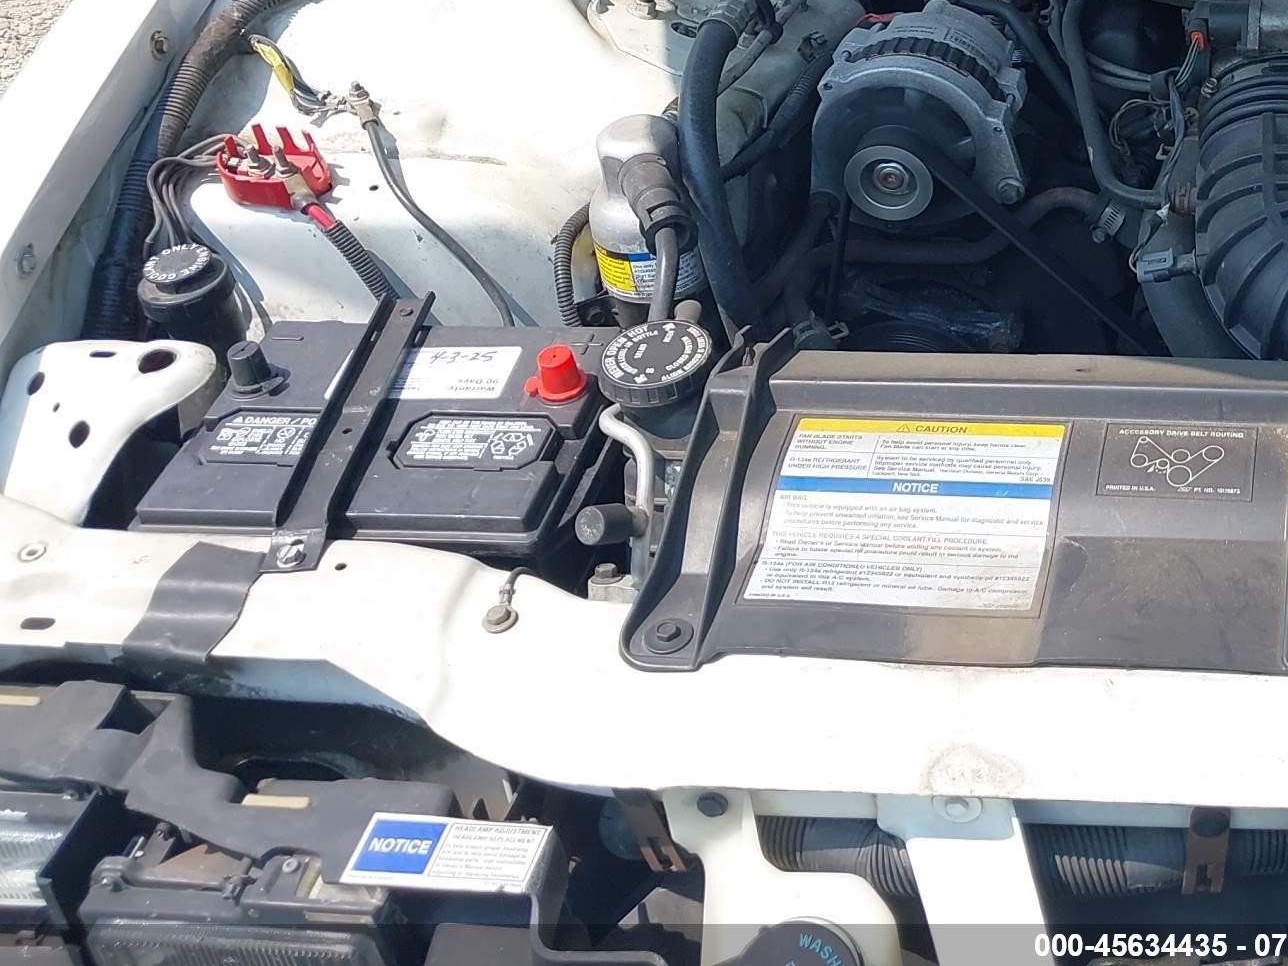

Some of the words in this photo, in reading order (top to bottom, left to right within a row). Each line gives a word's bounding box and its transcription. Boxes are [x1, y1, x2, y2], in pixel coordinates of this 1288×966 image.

[161, 242, 201, 255] ONLY
[143, 255, 177, 281] COOLANT
[181, 247, 210, 276] ENGINE
[627, 324, 649, 338] HOT
[631, 330, 659, 343] BOTTLE
[606, 336, 628, 356] OPEN
[430, 350, 499, 365] 4-3-25
[604, 356, 625, 379] NEVER
[457, 377, 484, 385] Days
[449, 385, 496, 393] Warranty
[244, 416, 291, 425] DANGER
[915, 425, 969, 434] CAUTION
[1118, 428, 1166, 436] ACCESSORY
[1166, 429, 1191, 437] DRIVE
[1191, 430, 1209, 438] BELT
[1209, 430, 1245, 439] ROUTING
[892, 481, 941, 494] NOTICE
[1105, 483, 1131, 492] PRINTED
[1131, 484, 1139, 492] IN
[454, 825, 494, 834] HEADLAMP
[494, 826, 543, 836] ADJUSTMENT
[367, 837, 434, 855] NOTICE
